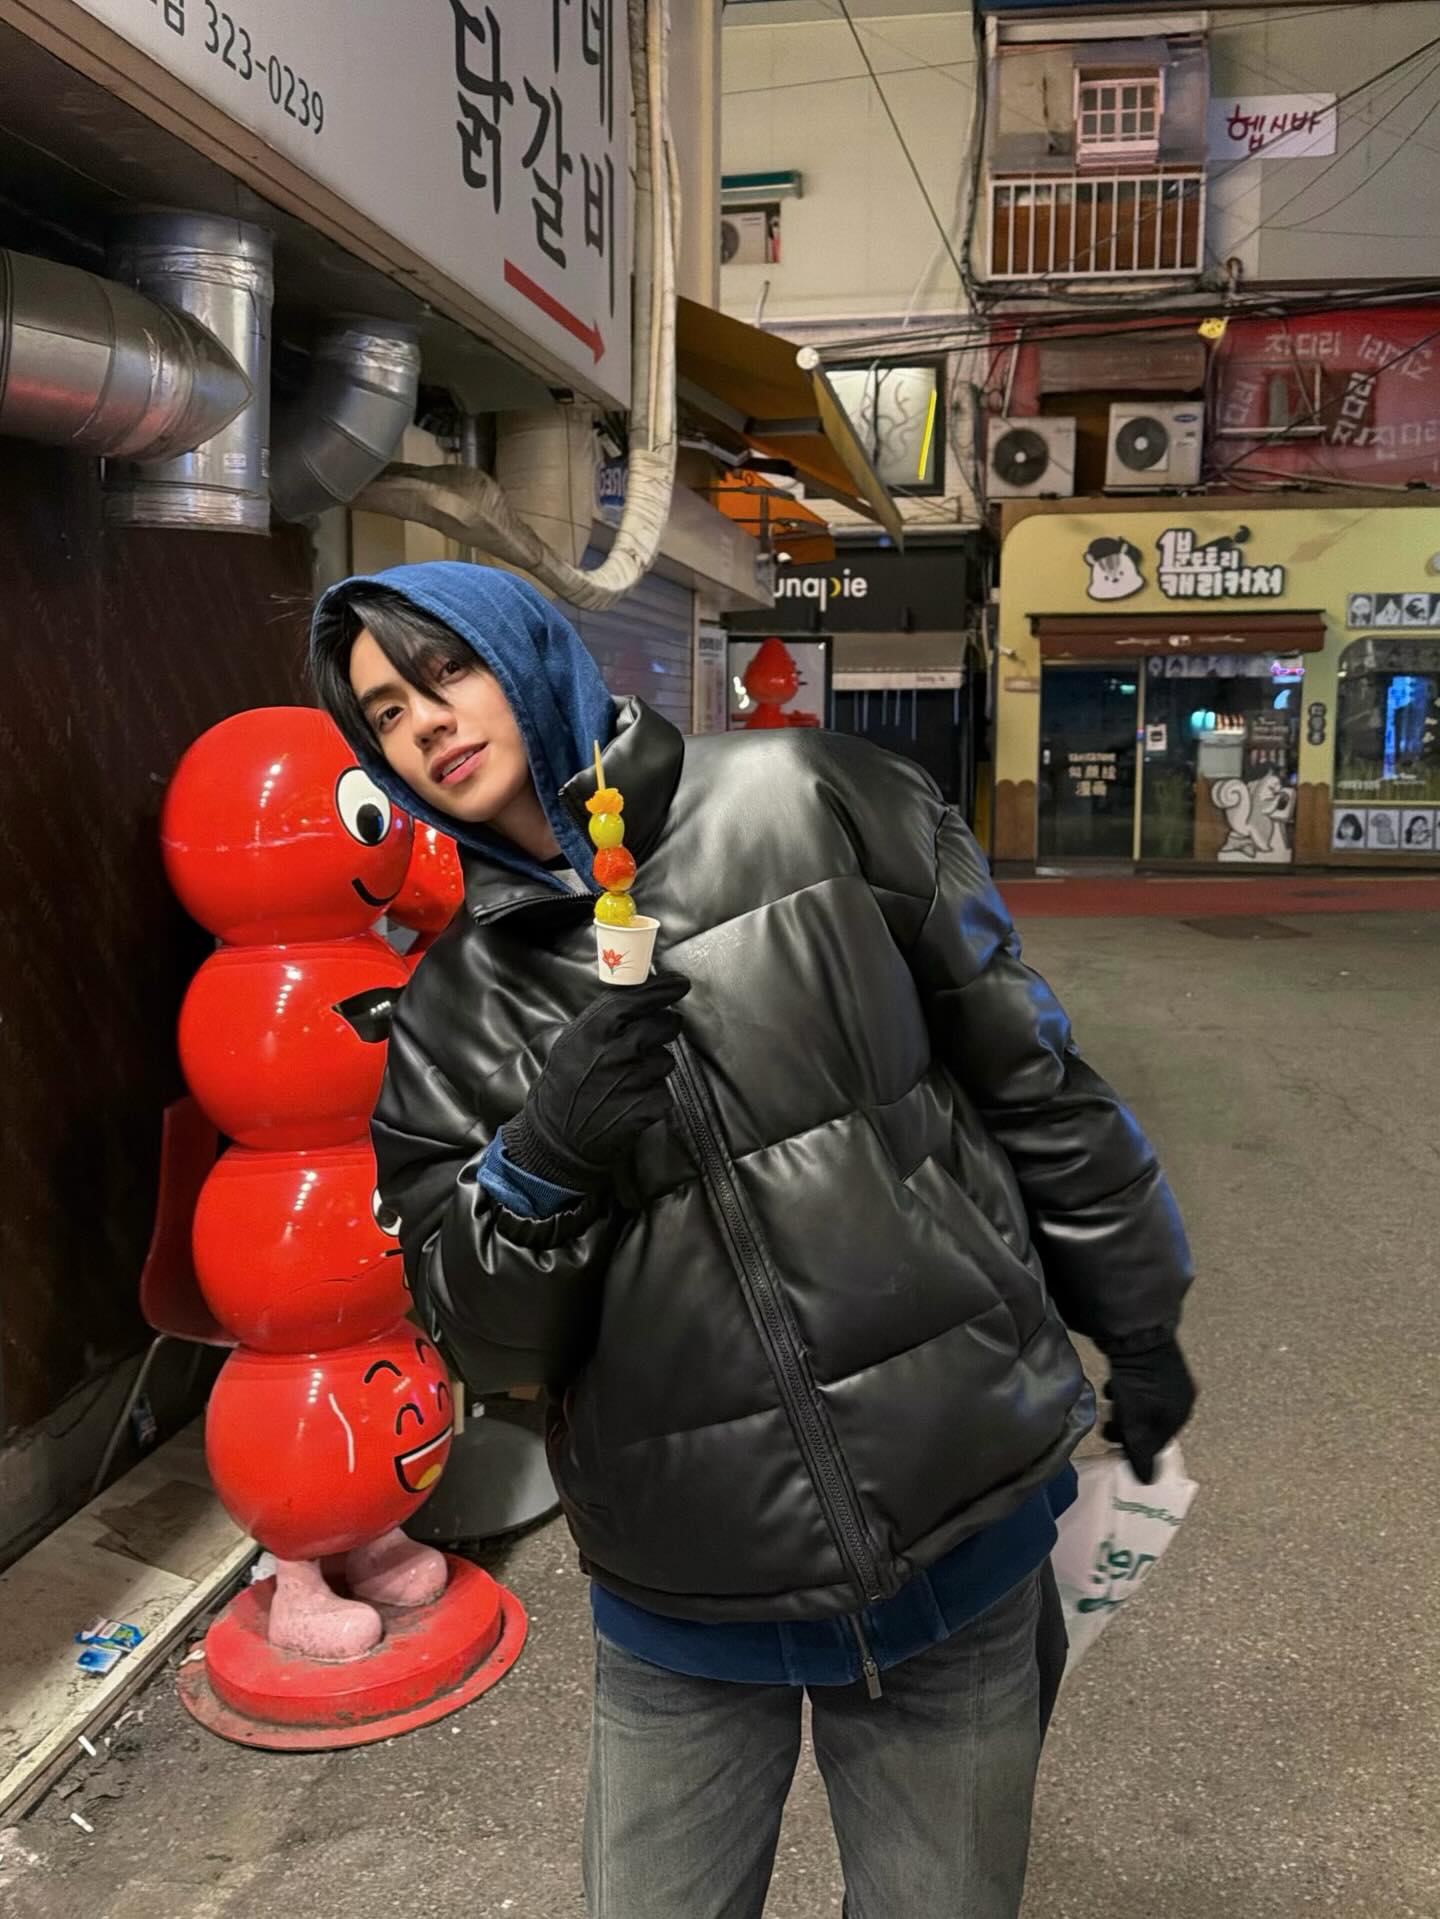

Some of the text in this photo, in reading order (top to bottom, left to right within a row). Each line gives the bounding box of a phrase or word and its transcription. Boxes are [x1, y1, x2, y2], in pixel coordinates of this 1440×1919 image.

[204, 0, 324, 135] 323-0239
[450, 0, 615, 319] 닭갈비
[1226, 103, 1322, 153] 헵시바
[1160, 567, 1282, 597] 캐리커처
